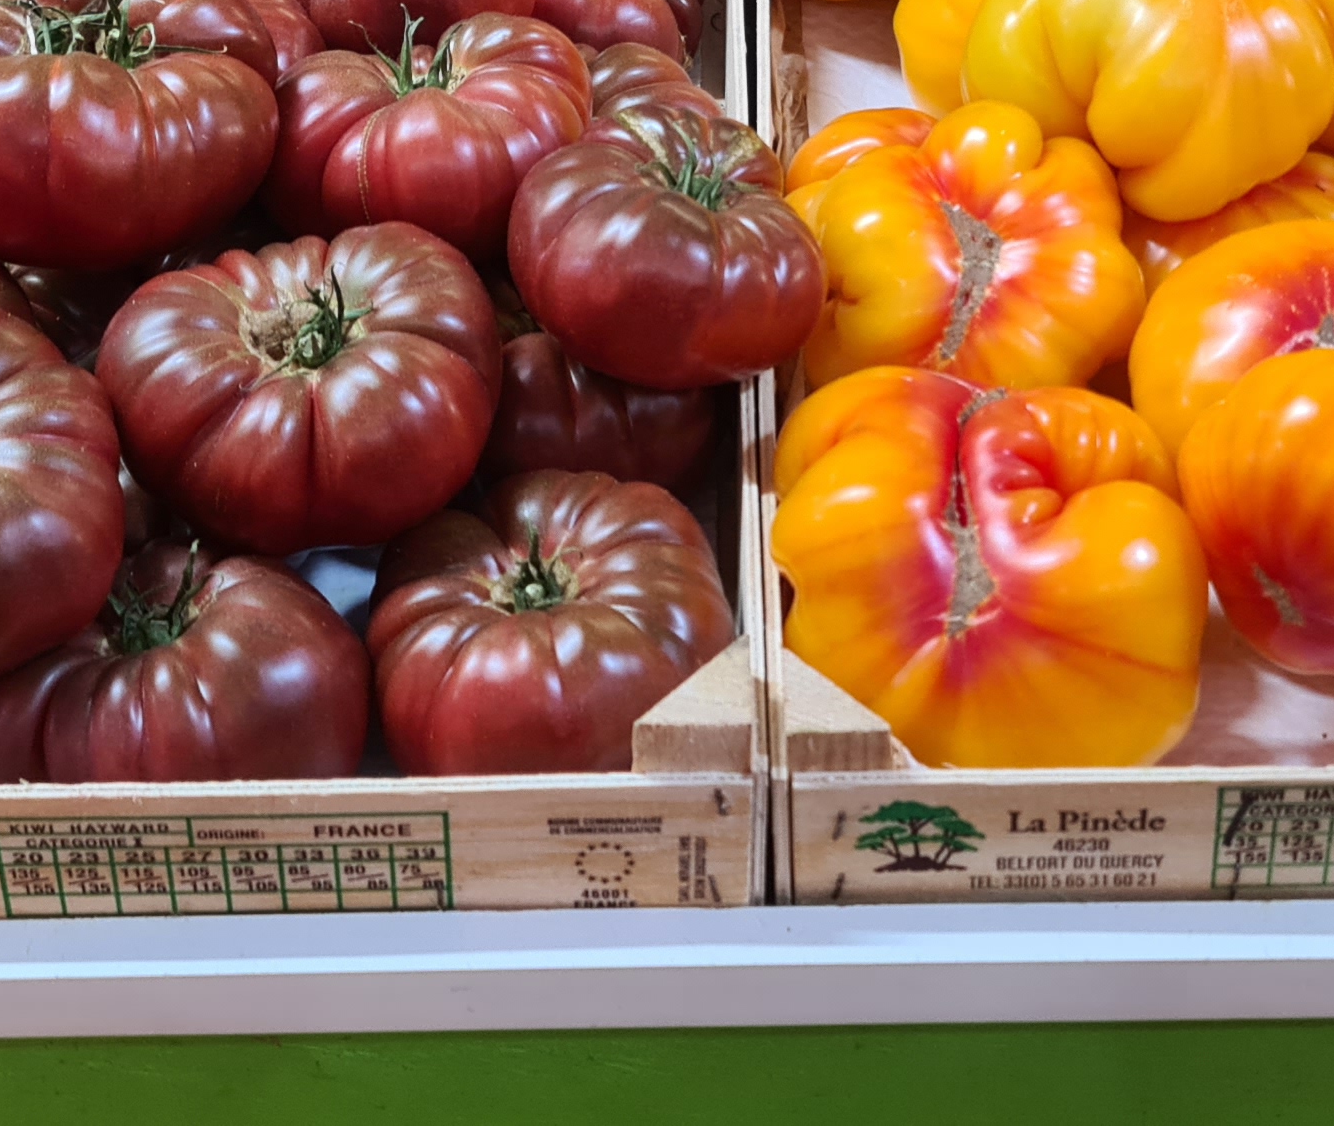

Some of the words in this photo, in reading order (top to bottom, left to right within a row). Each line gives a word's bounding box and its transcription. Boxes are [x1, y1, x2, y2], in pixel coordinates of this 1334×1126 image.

[1008, 811, 1046, 833] La
[1058, 809, 1166, 832] Pinède
[8, 824, 55, 834] KIWI
[70, 824, 169, 834] HAYWARD
[313, 824, 412, 838] FRANCE
[26, 838, 123, 848] CATEGORIE
[997, 857, 1066, 870] BELFORT
[1073, 856, 1094, 869] DU
[1100, 855, 1164, 869] QUERCY
